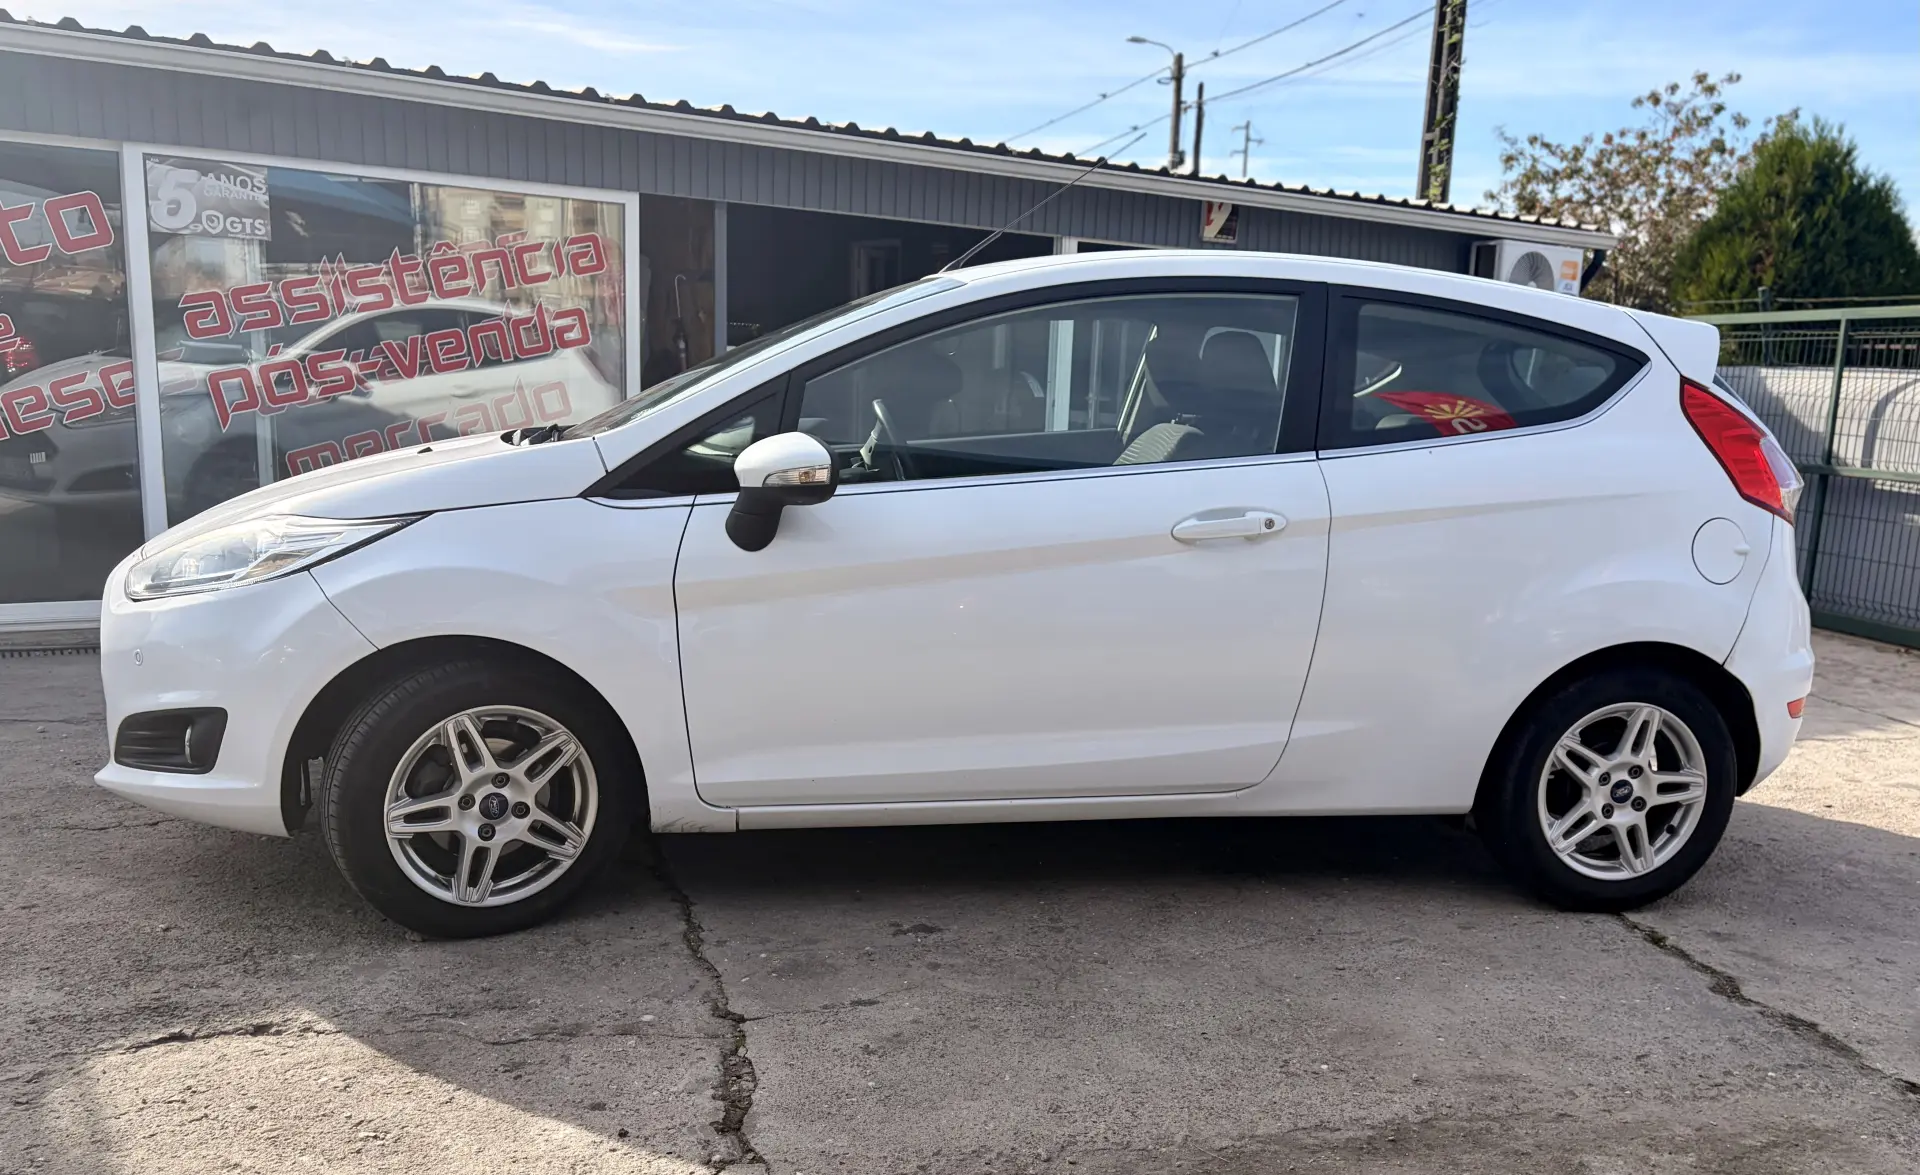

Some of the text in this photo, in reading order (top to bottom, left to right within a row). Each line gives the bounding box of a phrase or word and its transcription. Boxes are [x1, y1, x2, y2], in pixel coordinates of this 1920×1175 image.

[204, 172, 267, 195] ANOS
[225, 216, 266, 235] GTS
[178, 231, 607, 340] assistência
[206, 298, 592, 433] pós-venda
